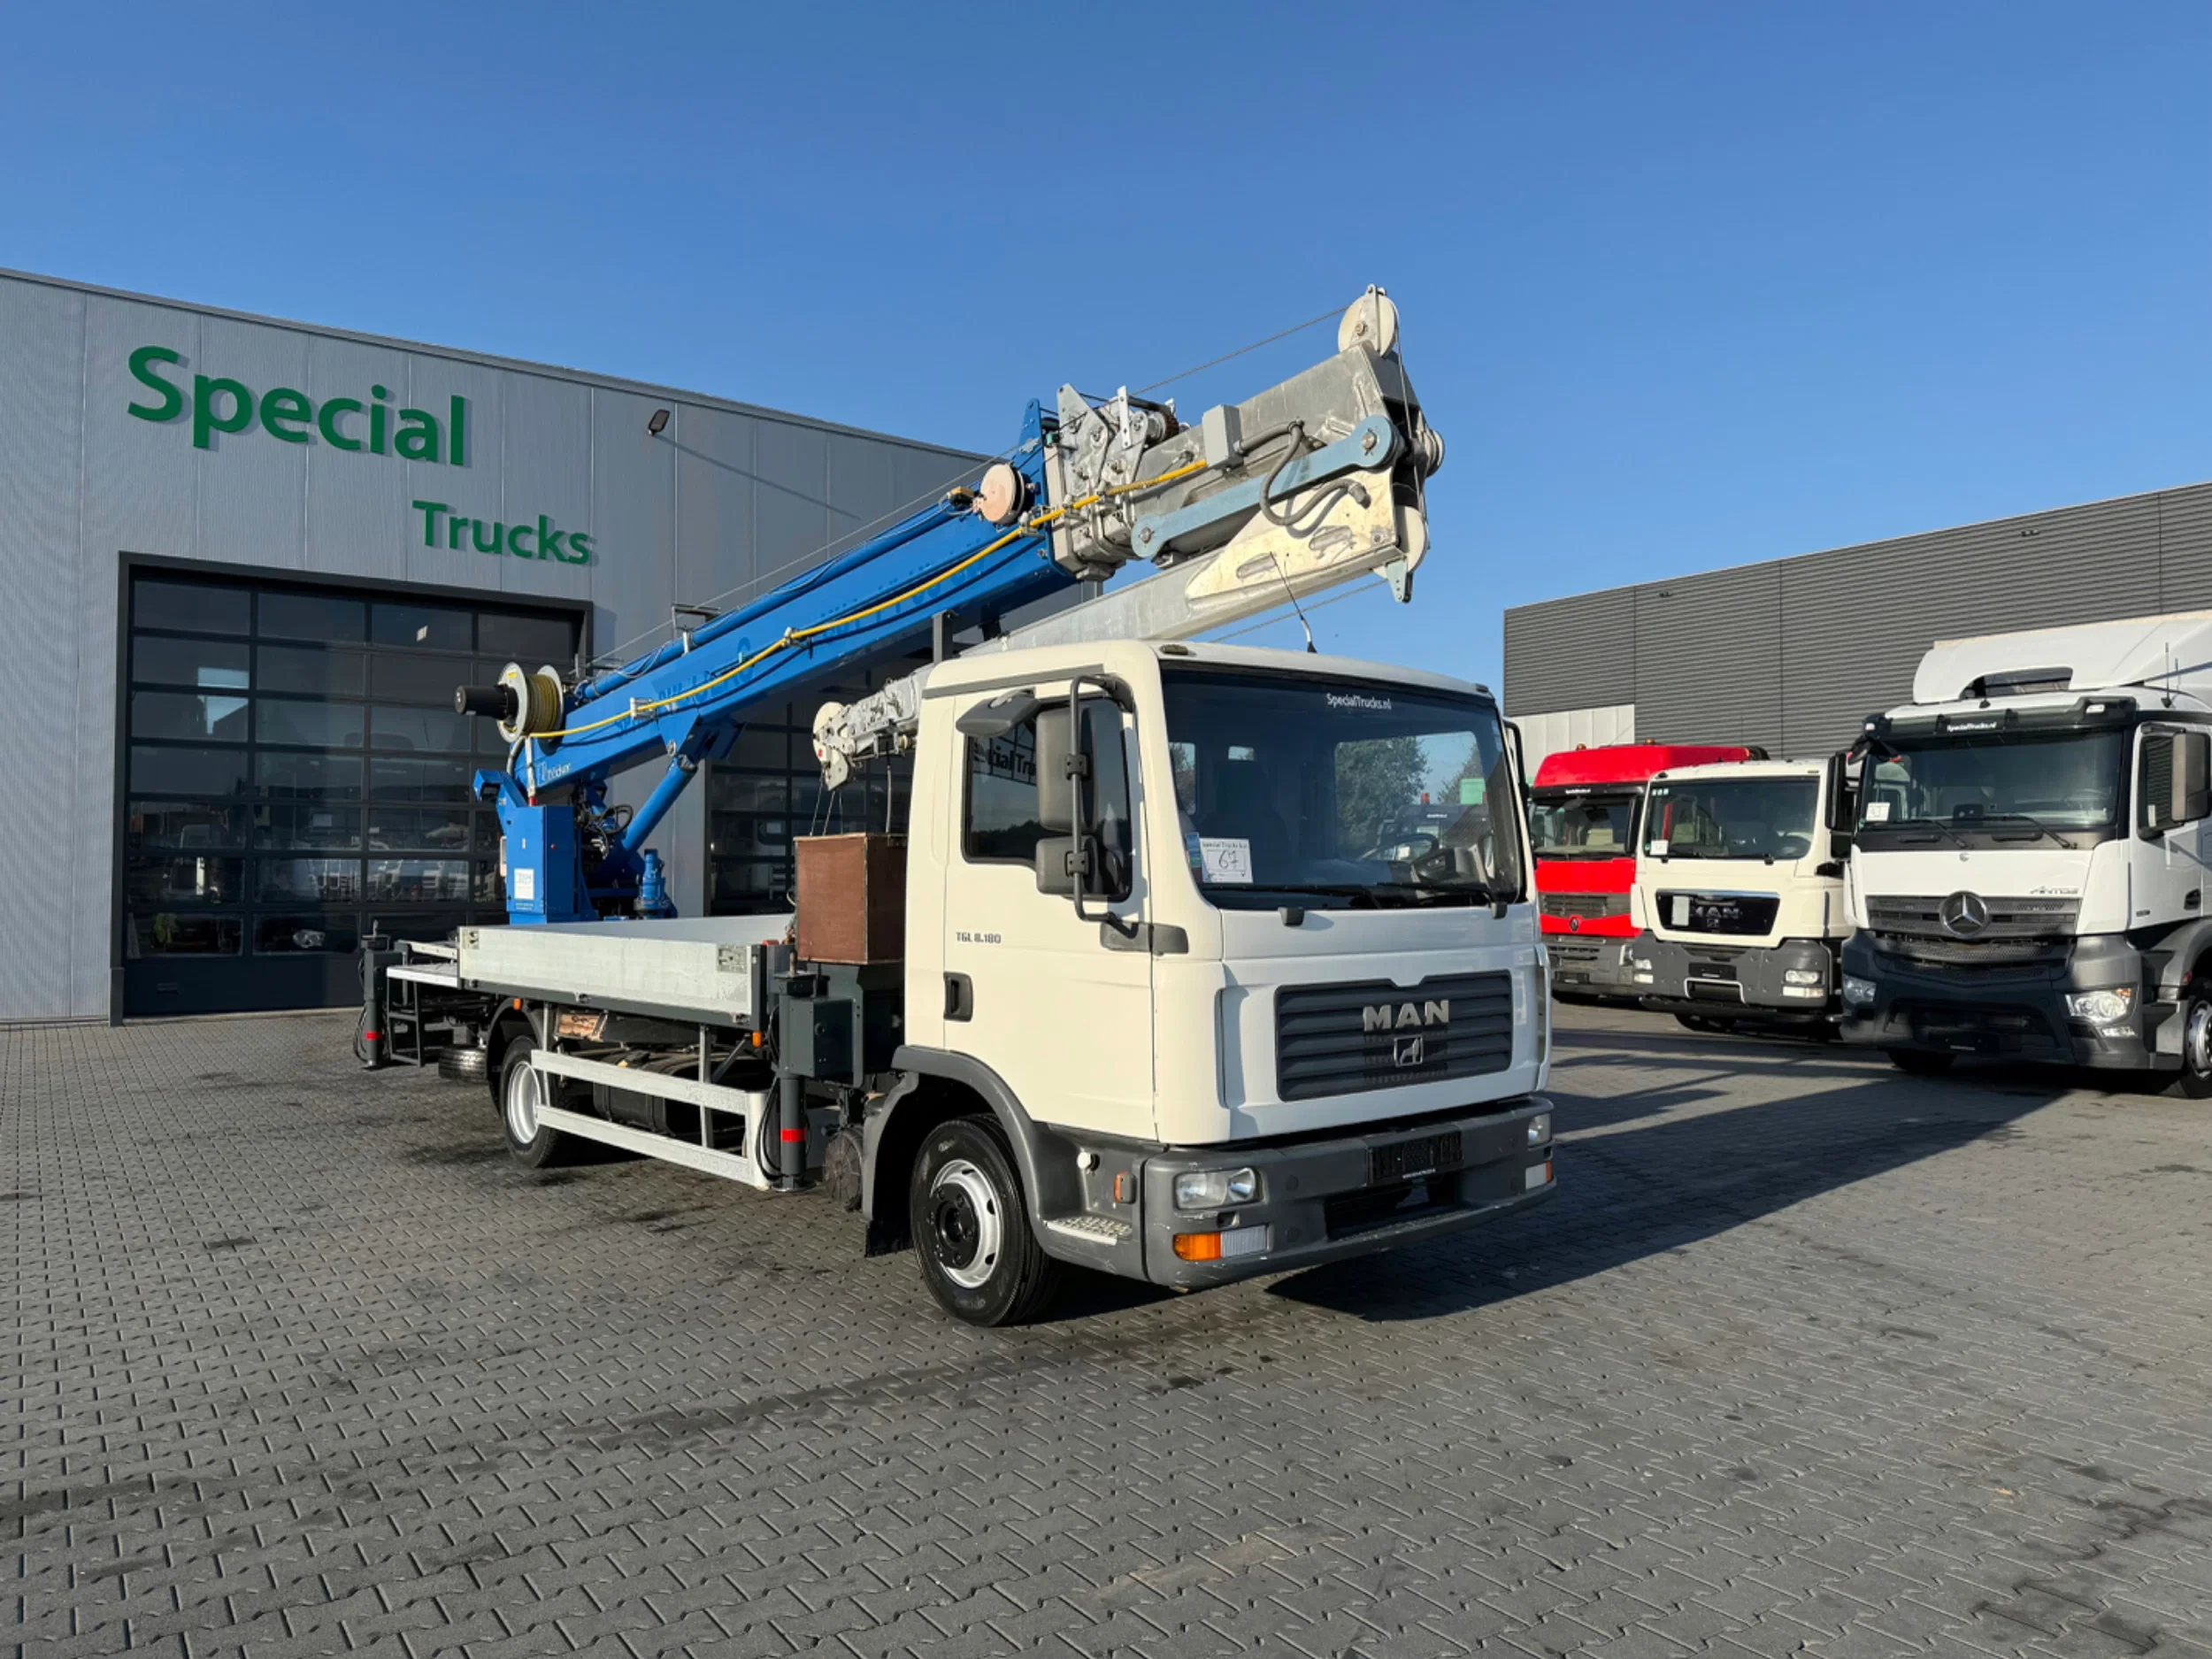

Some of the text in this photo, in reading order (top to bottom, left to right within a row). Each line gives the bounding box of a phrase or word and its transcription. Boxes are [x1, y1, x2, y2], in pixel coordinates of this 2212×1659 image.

[127, 345, 465, 465] Special
[412, 500, 591, 565] Trucks
[1325, 693, 1392, 710] SpecialTrucks.nl
[1363, 999, 1448, 1032] MAN
